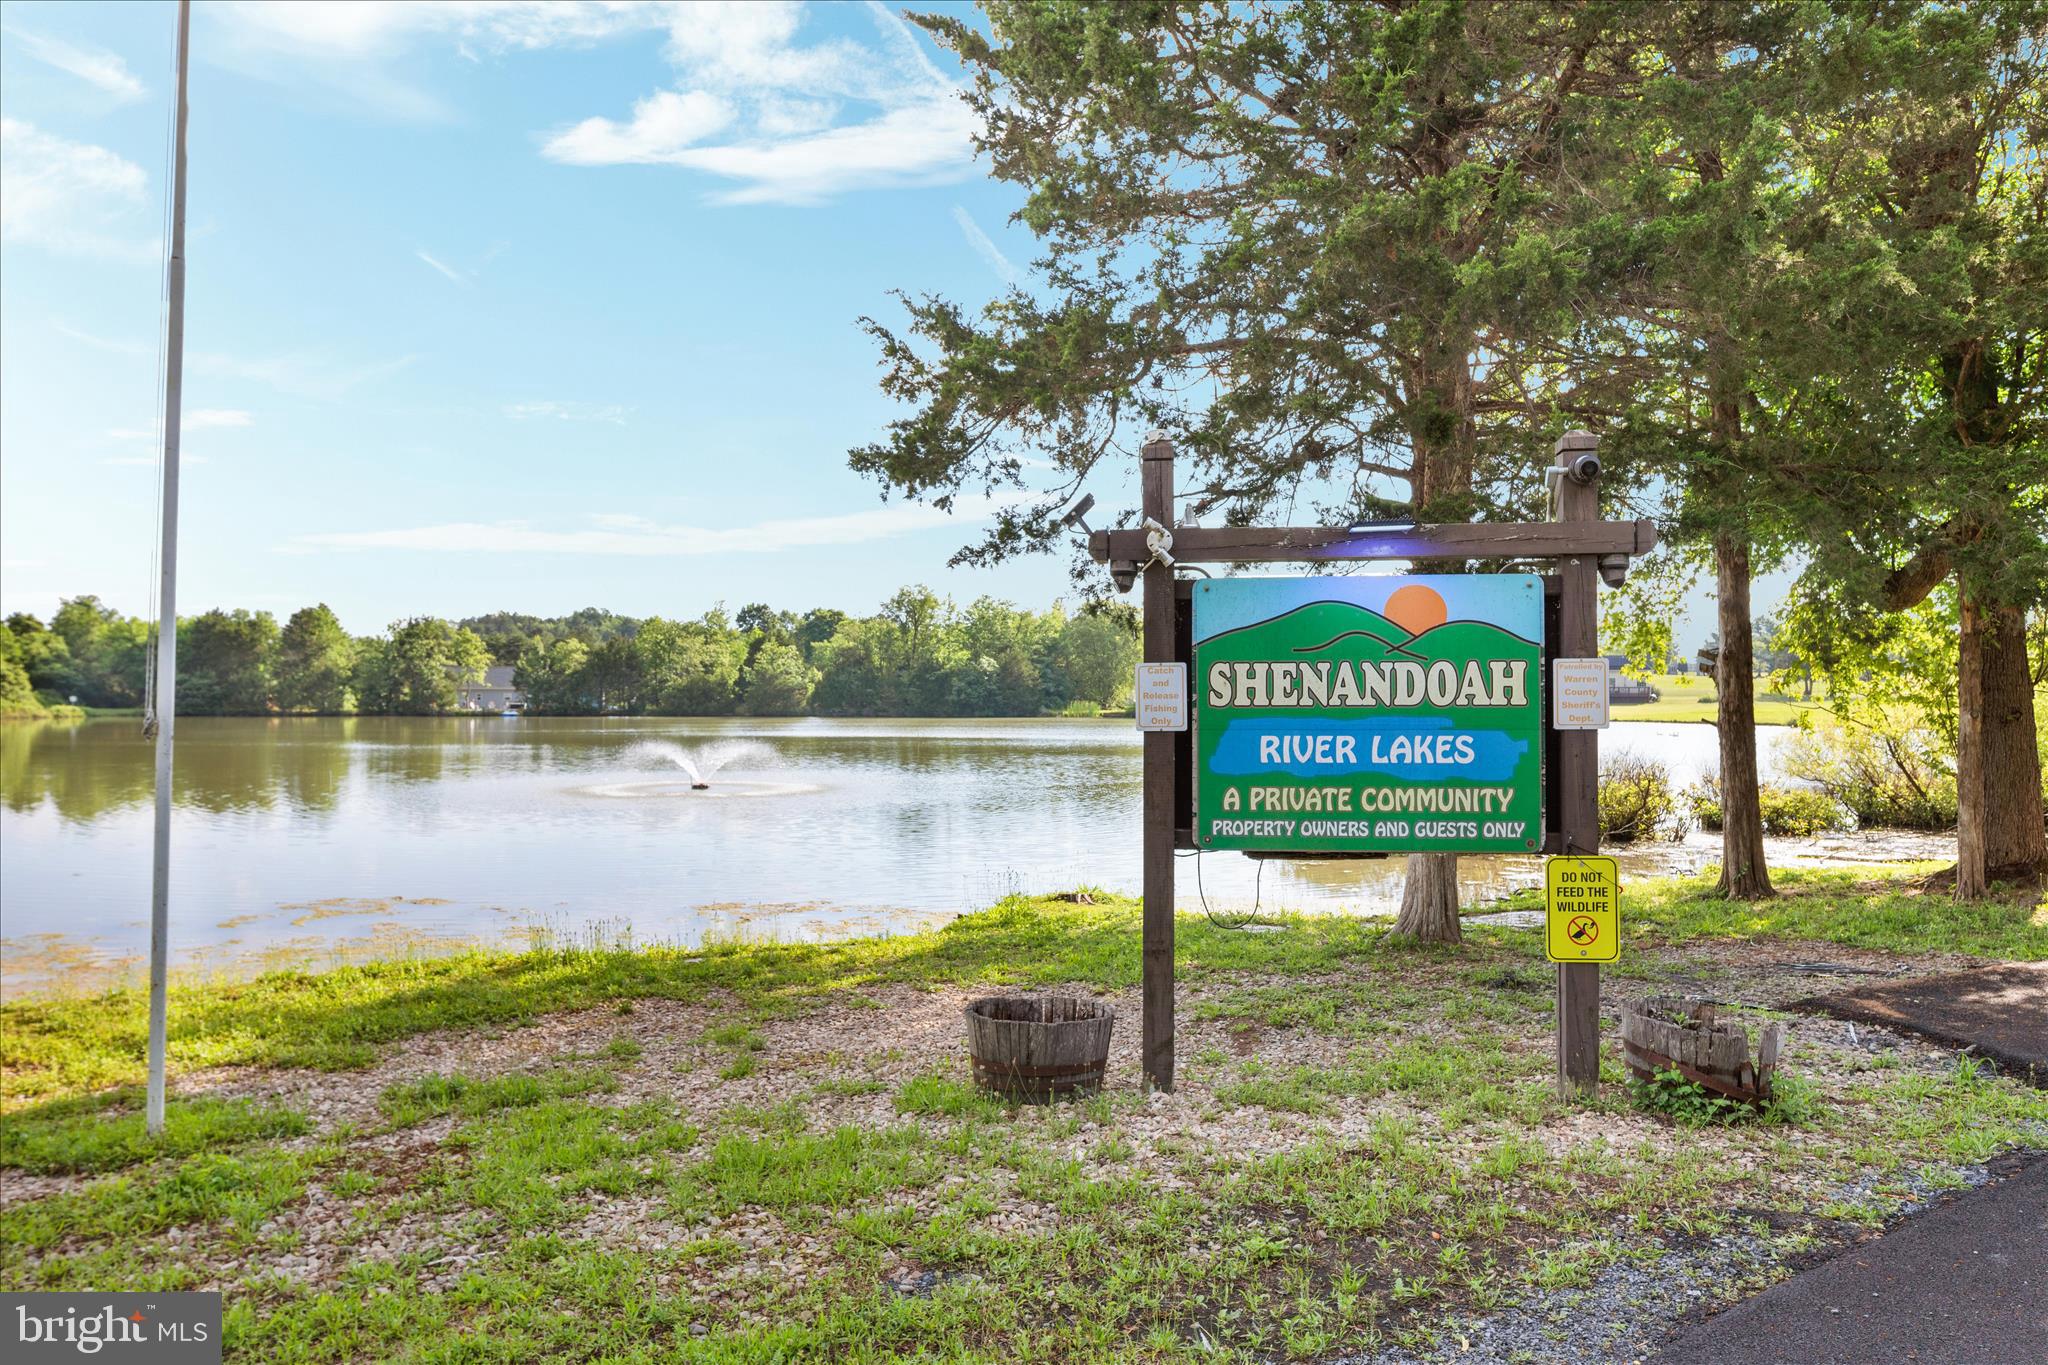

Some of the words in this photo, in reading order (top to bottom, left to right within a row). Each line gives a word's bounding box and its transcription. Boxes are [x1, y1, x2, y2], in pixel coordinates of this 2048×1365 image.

[1147, 666, 1174, 675] Catch
[1564, 675, 1598, 683] Warren
[1208, 660, 1529, 708] SHENANDOAH
[1143, 692, 1179, 700] Release
[1564, 688, 1598, 697] County
[1144, 704, 1178, 713] Fishing
[1561, 701, 1601, 709] Sheriff's
[1151, 717, 1171, 725] Only
[1568, 714, 1593, 723] Dept.
[1260, 735, 1357, 764] RIVER
[1371, 735, 1475, 764] LAKES
[1223, 787, 1241, 811] A
[1250, 787, 1353, 812] PRIVATE
[1361, 788, 1515, 812] COMMUNITY
[1212, 820, 1296, 836] PROPERTY
[1301, 821, 1369, 837] OWNERS
[1374, 821, 1409, 837] AND
[1415, 822, 1477, 838] GUESTS
[1483, 822, 1526, 838] ONLY
[1561, 872, 1577, 882] DO
[1581, 872, 1602, 882] NOT
[1556, 887, 1584, 897] FEED
[1587, 887, 1608, 897] THE
[1557, 902, 1609, 912] WILDLIFE
